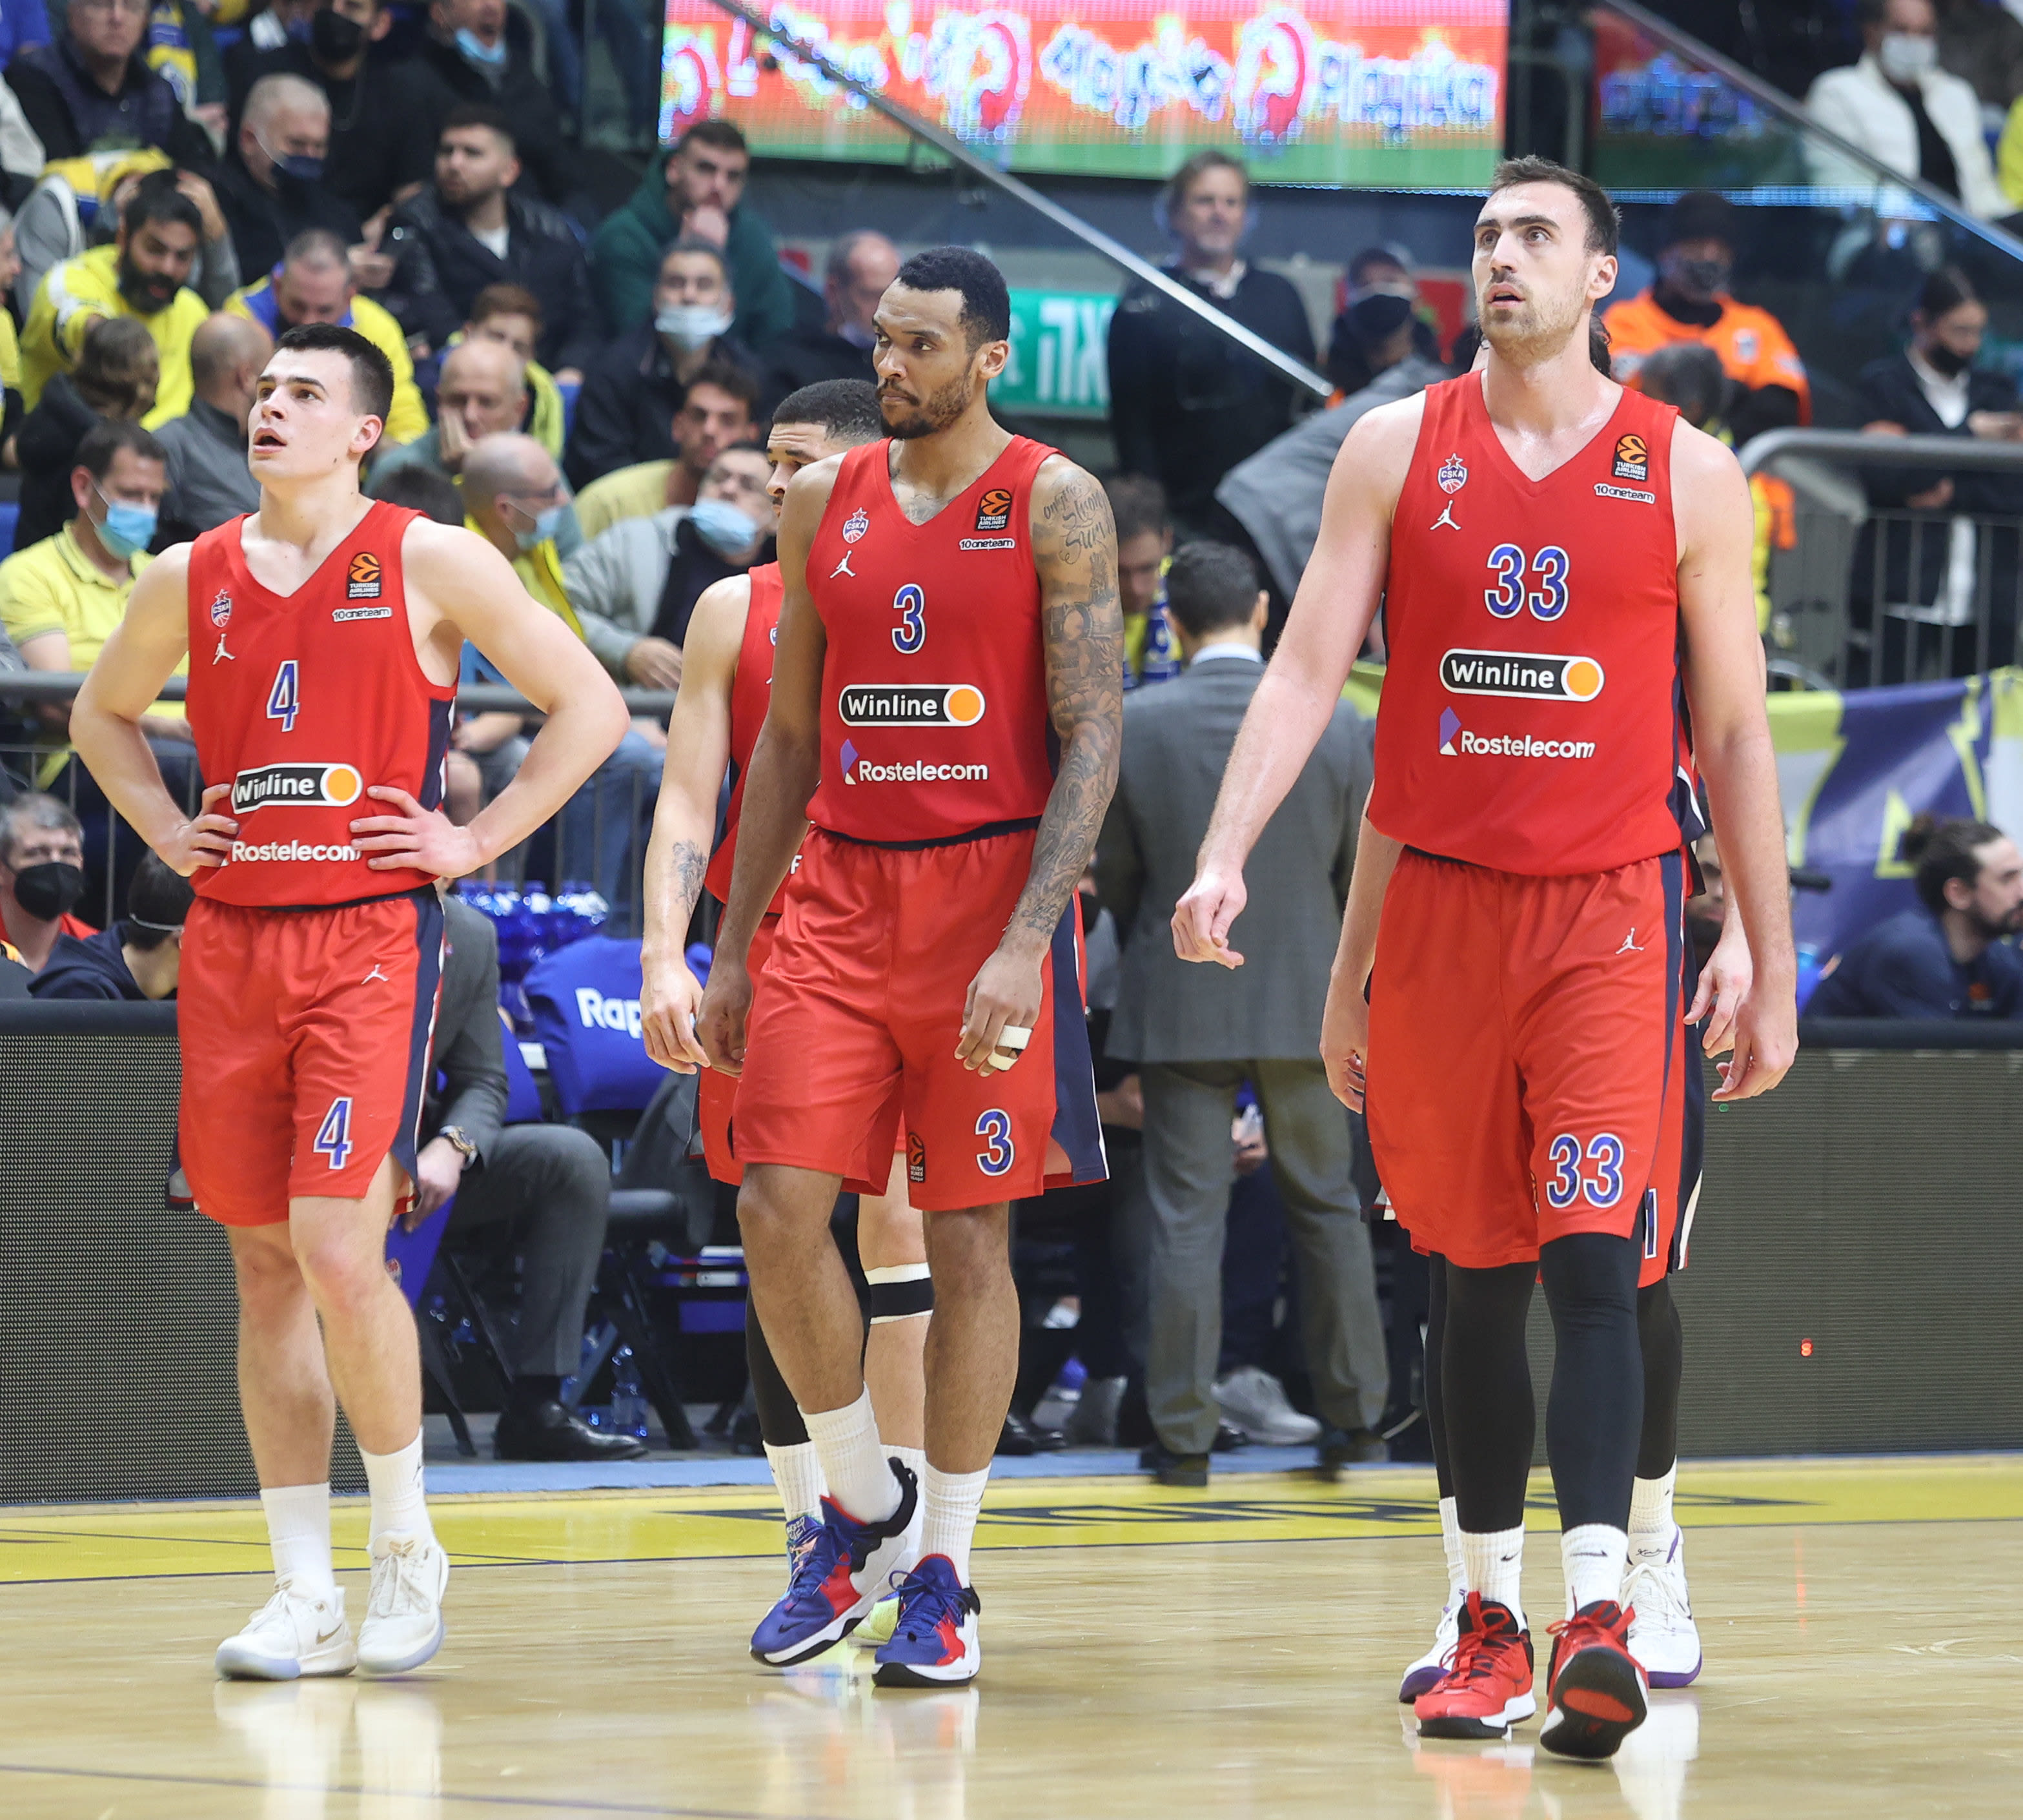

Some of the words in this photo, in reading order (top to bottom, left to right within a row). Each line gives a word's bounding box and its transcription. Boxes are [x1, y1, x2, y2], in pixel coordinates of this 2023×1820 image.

[1485, 544, 1569, 621] 33
[891, 583, 926, 654] 3
[267, 660, 300, 733] 4
[1450, 659, 1554, 688] Winline
[847, 695, 938, 717] Winline
[859, 761, 988, 782] Rostelecom
[1461, 731, 1596, 759] Rostelecom
[237, 773, 316, 803] Winline
[575, 987, 643, 1039] Rap
[313, 1097, 354, 1170] 4
[975, 1108, 1015, 1176] 3
[1546, 1133, 1624, 1208] 33
